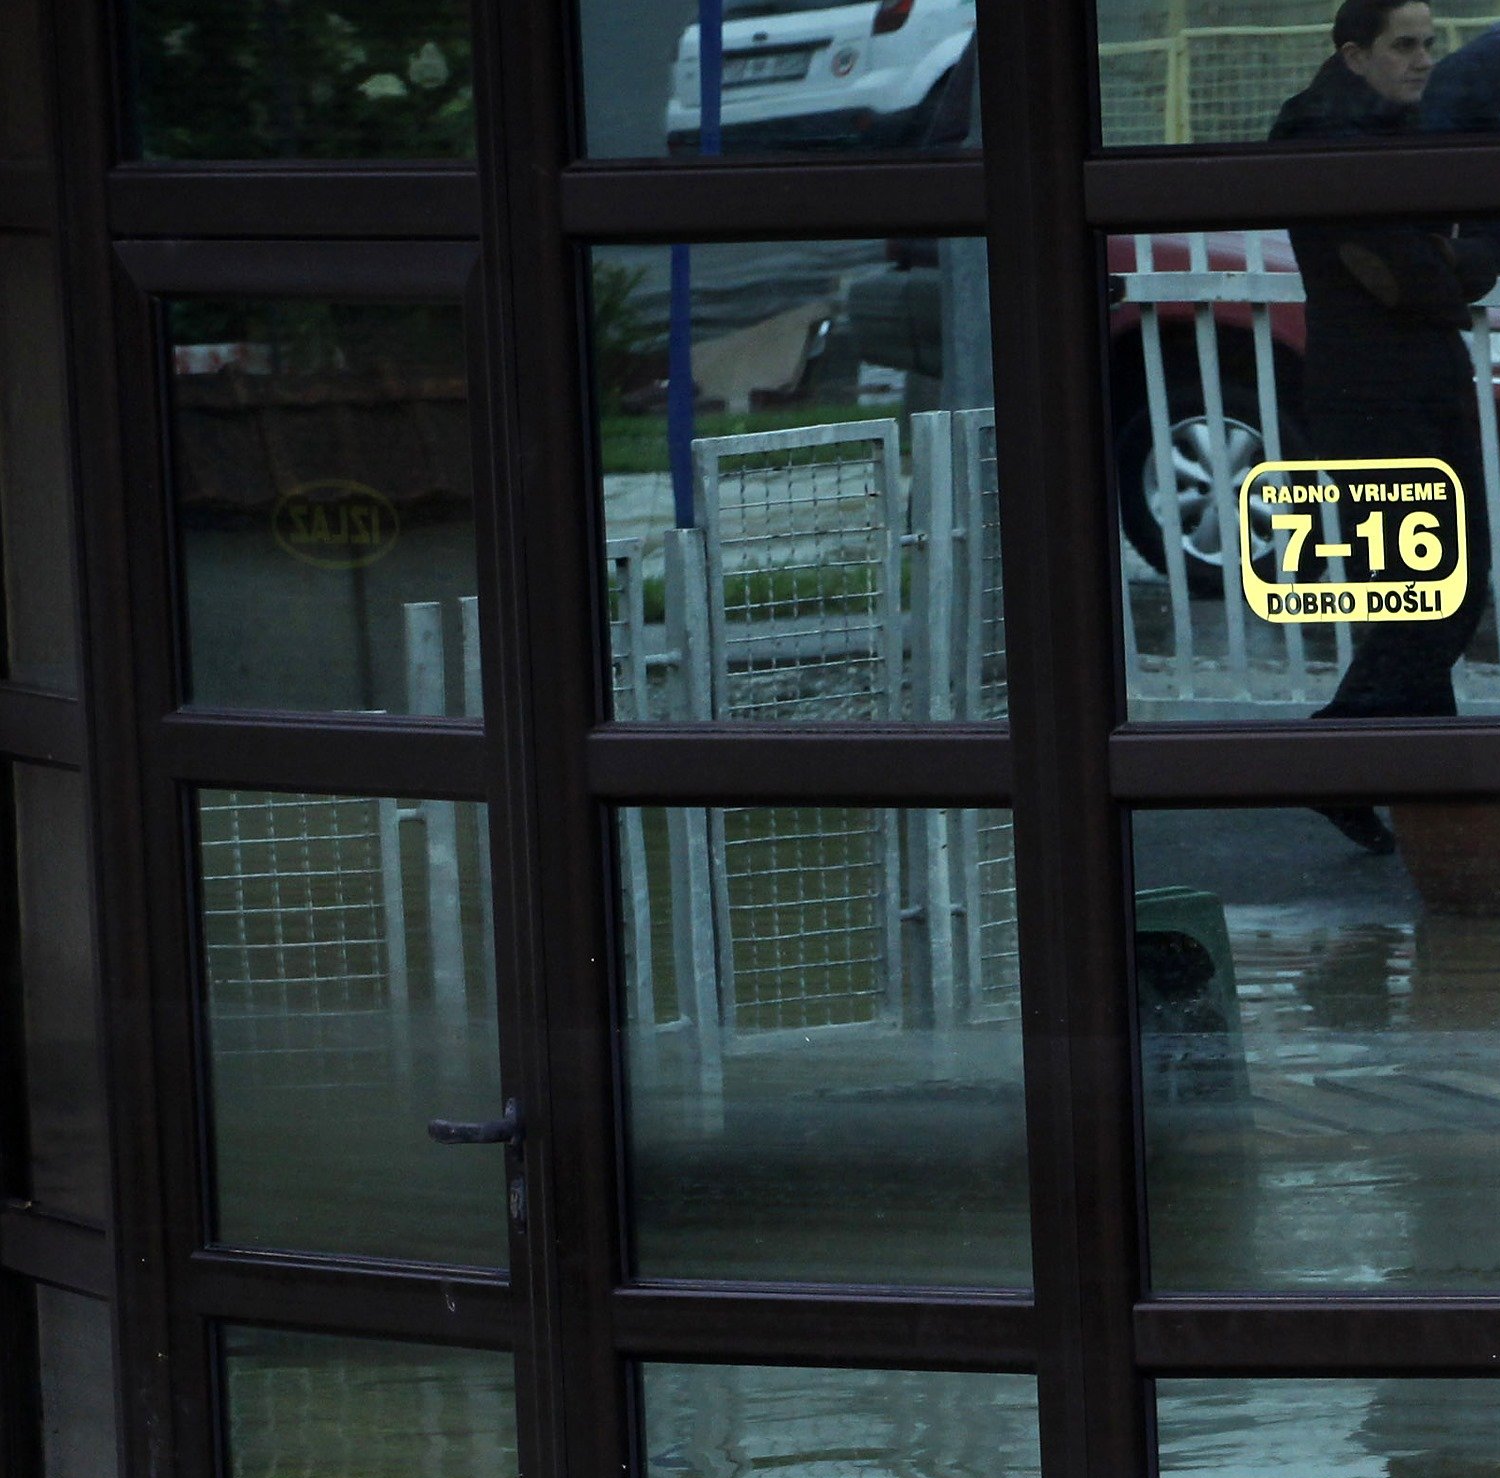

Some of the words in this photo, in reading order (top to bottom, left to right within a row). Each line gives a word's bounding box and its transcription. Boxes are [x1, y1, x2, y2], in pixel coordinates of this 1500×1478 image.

[1262, 485, 1340, 504] RADNO
[1348, 482, 1447, 503] VRIJEME
[1271, 511, 1443, 572] 7-16
[1267, 591, 1355, 615] DOBRO
[1366, 585, 1442, 614] DOŠLI
